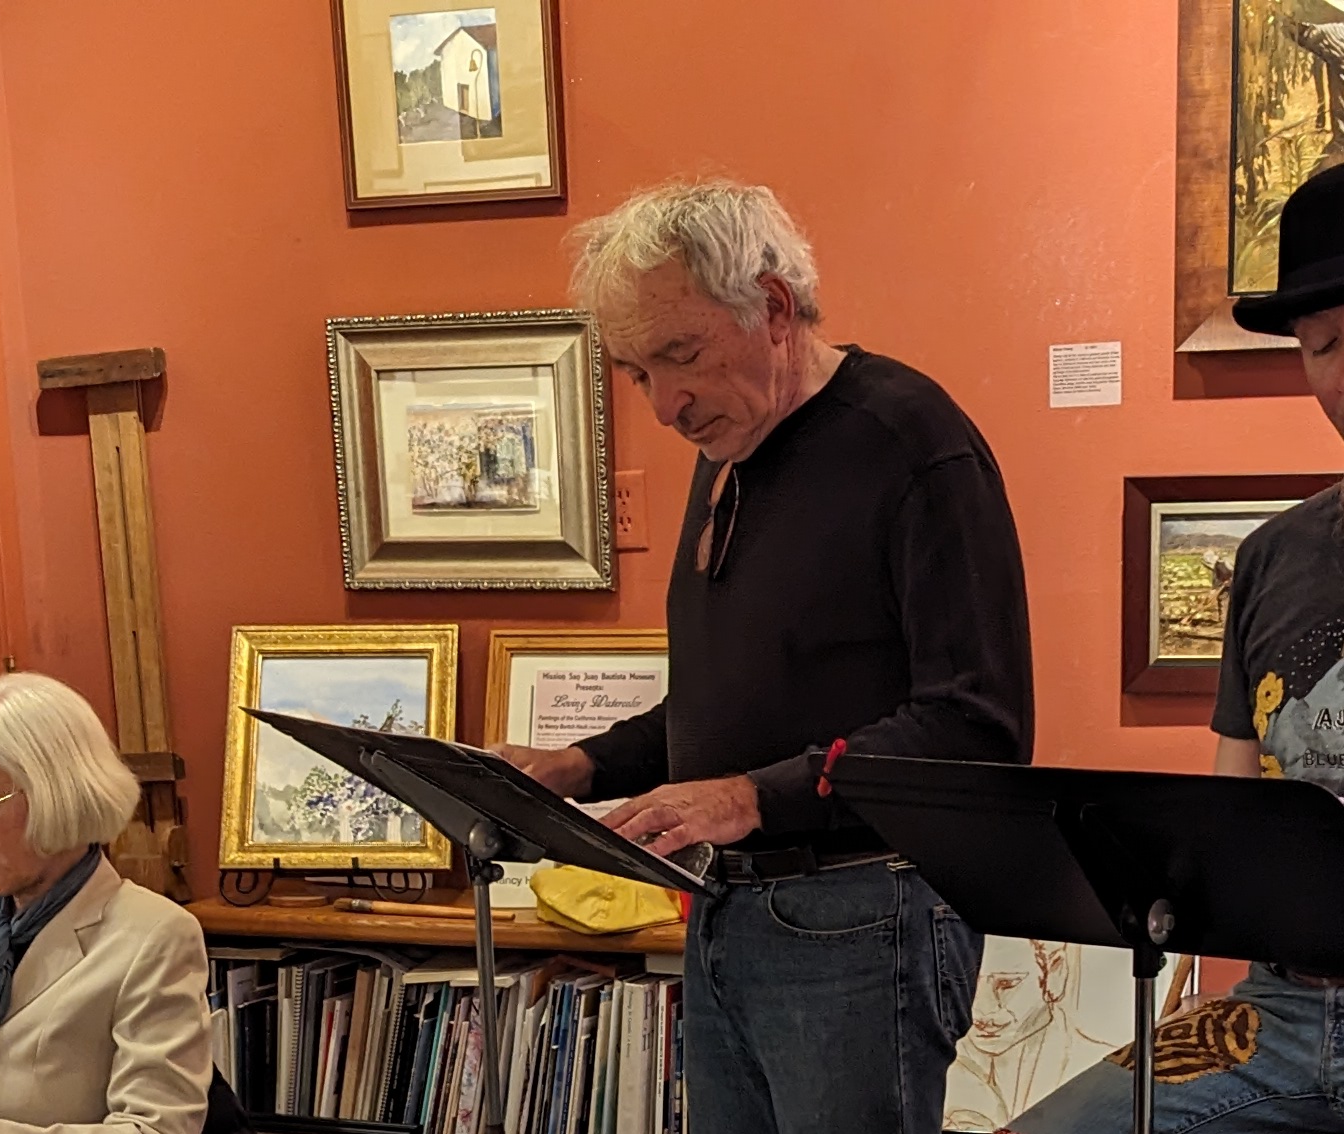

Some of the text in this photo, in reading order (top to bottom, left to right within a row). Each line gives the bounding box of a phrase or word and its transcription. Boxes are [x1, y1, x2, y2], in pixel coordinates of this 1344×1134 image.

[542, 672, 655, 682] Mission San Juan Bautista Museum
[551, 694, 642, 713] Loving Watercolor
